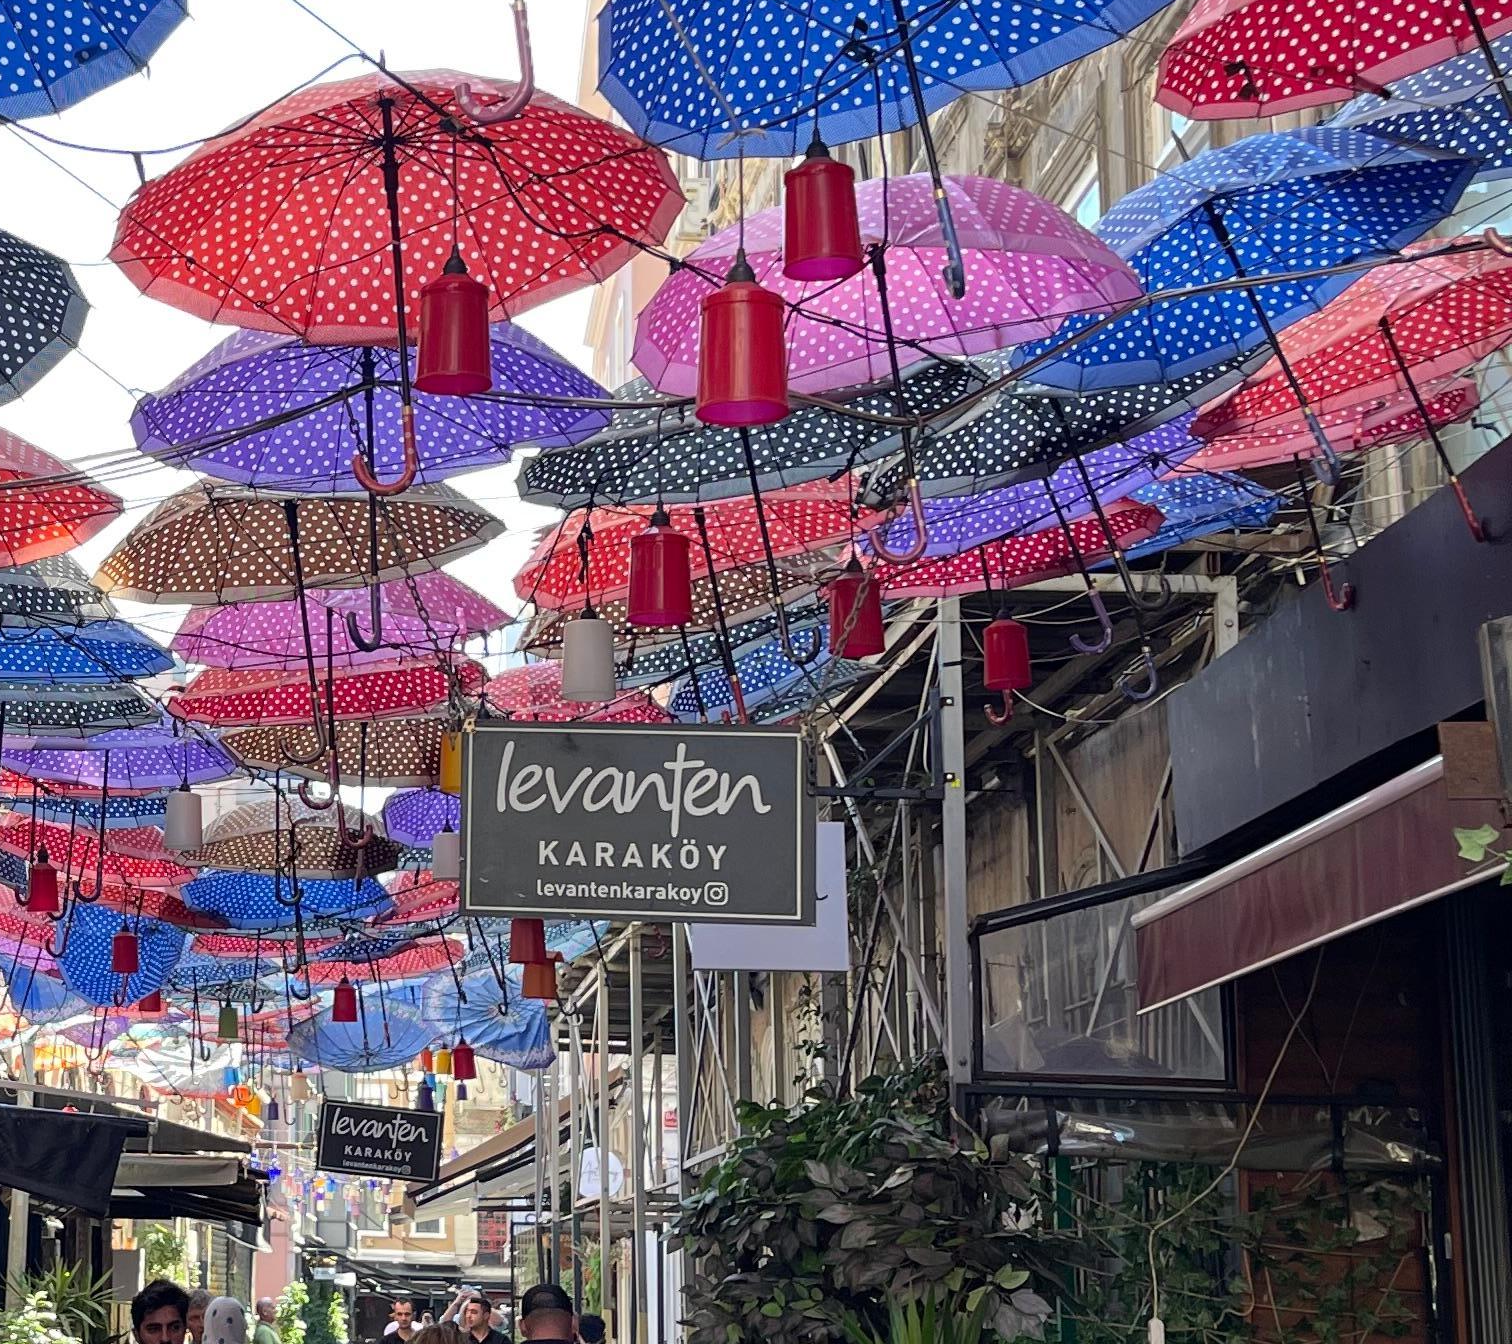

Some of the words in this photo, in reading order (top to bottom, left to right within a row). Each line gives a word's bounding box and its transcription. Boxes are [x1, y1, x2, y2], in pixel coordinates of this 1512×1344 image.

[496, 741, 772, 837] levanten
[538, 839, 728, 871] KARAKÖY
[536, 878, 703, 905] levantenkarakoy
[331, 1107, 429, 1148] levanten
[344, 1145, 413, 1162] KARAKÖY
